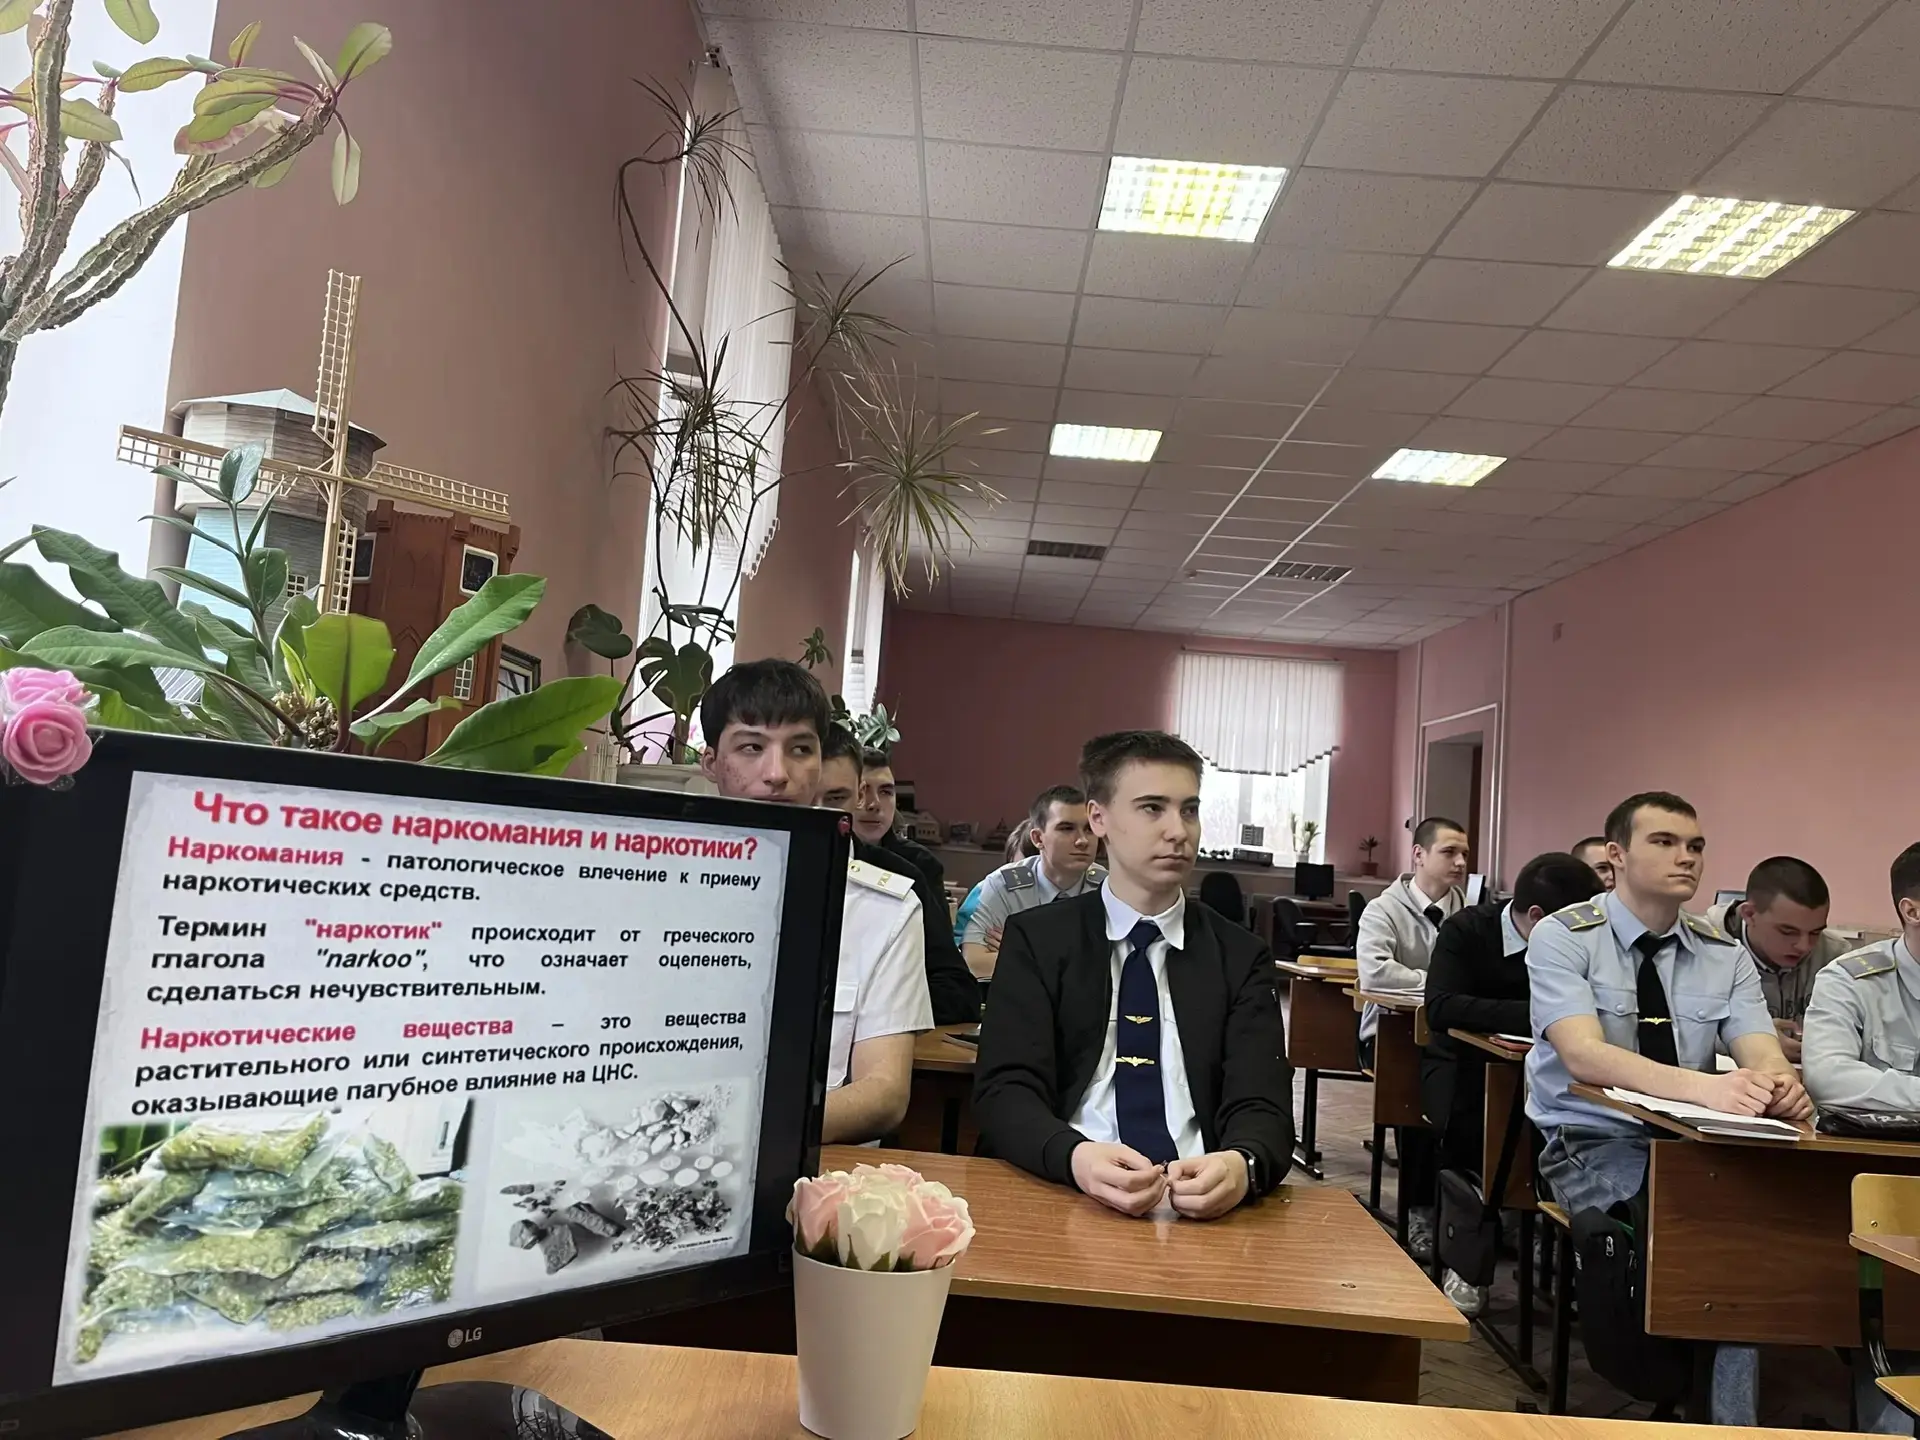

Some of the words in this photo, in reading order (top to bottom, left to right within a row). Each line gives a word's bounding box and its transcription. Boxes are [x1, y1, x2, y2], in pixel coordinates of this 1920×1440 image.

[194, 791, 269, 826] Что
[280, 806, 383, 834] такое
[392, 815, 583, 848] наркомания
[590, 831, 607, 850] и
[615, 833, 758, 860] наркотики?
[168, 836, 343, 866] Наркомания
[387, 855, 564, 877] патологическое
[579, 866, 667, 882] влечение
[680, 872, 689, 883] к
[700, 873, 761, 891] приему
[163, 874, 371, 897] наркотических
[380, 883, 480, 902] средств.
[158, 915, 266, 942] Термин
[305, 919, 442, 943] "наркотик"
[472, 927, 596, 945] происходит
[620, 930, 641, 942] от
[663, 931, 754, 947] греческого
[151, 953, 265, 969] глагола
[317, 948, 428, 972] "narkoo",
[469, 954, 505, 968] что
[541, 954, 629, 967] означает
[658, 955, 751, 970] оцепенеть,
[147, 984, 301, 1005] сделаться
[310, 982, 545, 1003] нечувствительным.
[141, 1026, 356, 1053] Наркотические
[403, 1020, 513, 1039] вещества
[600, 1016, 631, 1029] это
[665, 1012, 746, 1028] вещества
[135, 1056, 350, 1085] растительного
[363, 1053, 410, 1069] или
[422, 1044, 590, 1066] синтетического
[600, 1037, 743, 1059] происхождения,
[132, 1086, 338, 1117] оказывающие
[347, 1076, 458, 1102] пагубное
[465, 1072, 557, 1091] влияние
[563, 1070, 585, 1084] на
[592, 1063, 638, 1084] ЦНС.
[465, 1327, 483, 1343] LG
